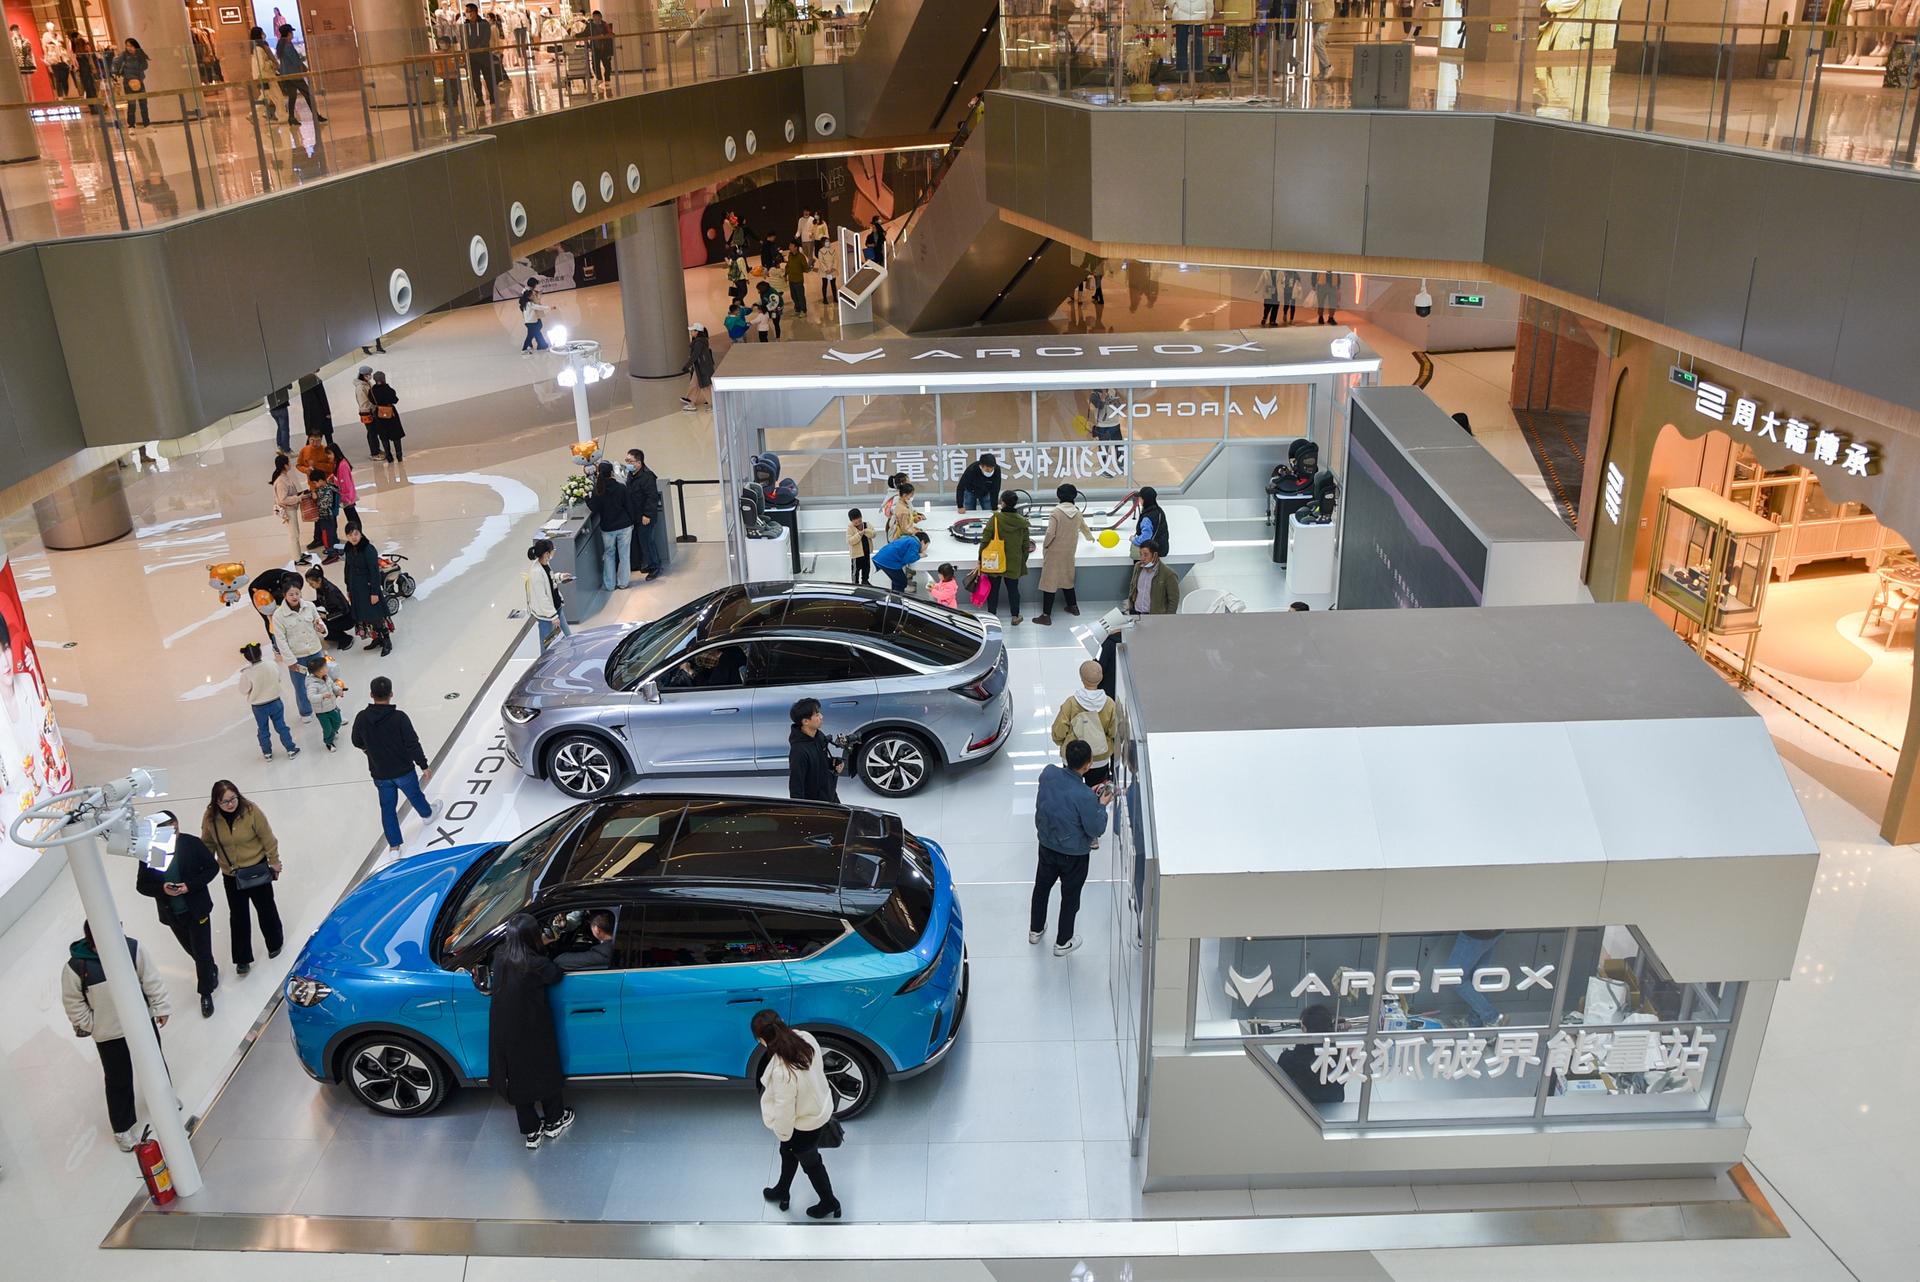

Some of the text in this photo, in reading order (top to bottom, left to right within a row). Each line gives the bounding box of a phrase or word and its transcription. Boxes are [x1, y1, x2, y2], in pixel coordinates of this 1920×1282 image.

[910, 341, 1267, 361] ARCFOX
[1290, 964, 1556, 998] ARCFOX
[1311, 1026, 1717, 1085] 极狐破界能量站
